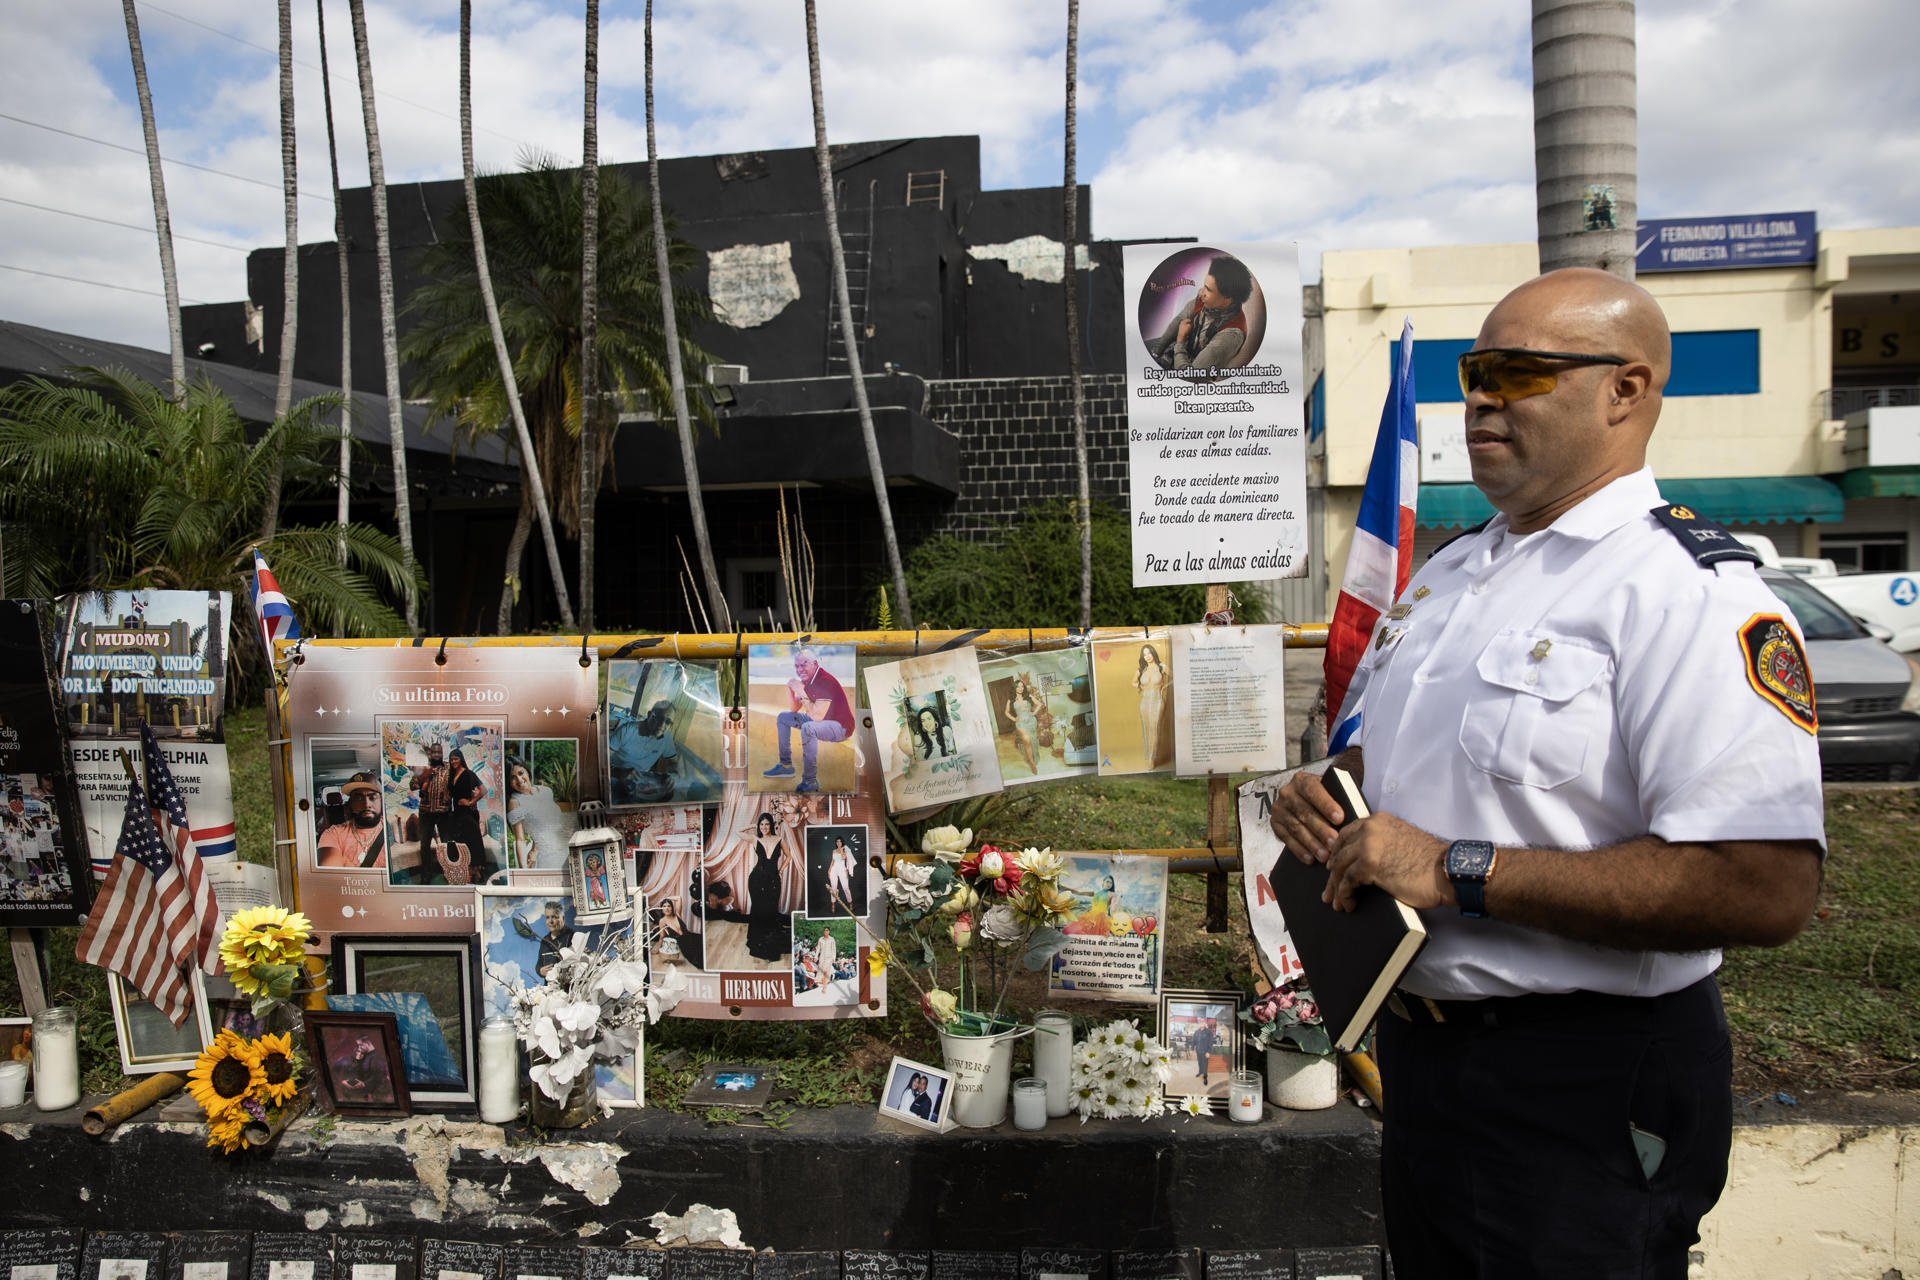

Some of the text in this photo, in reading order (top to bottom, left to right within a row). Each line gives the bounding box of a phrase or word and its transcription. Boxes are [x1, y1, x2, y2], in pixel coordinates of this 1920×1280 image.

[1660, 221, 1797, 243] FERNANDO VILLALONA
[1671, 245, 1728, 262] ORQUESTA
[1144, 364, 1281, 381] Rey medina & movimiento
[1138, 381, 1289, 398] unidos por la Dominicanidad.
[1175, 400, 1254, 415] Dicen presente.
[1130, 424, 1298, 442] Se solidarizan con los familiares
[1160, 445, 1171, 459] de
[1176, 448, 1198, 458] esas
[1201, 444, 1232, 458] almas
[1154, 472, 1279, 488] En ese accidente masivo
[1154, 490, 1279, 506] Donde cada dominicano
[1138, 508, 1295, 527] fue tocado de manera directa.
[1145, 553, 1168, 573] Paz
[1172, 559, 1181, 572] a
[1185, 551, 1204, 571] las
[1208, 550, 1246, 571] almas
[72, 654, 203, 671] MOVIMIENTO UNIDO
[86, 678, 103, 693] LA
[378, 687, 505, 702] Su ultima Foto
[344, 876, 370, 889] Tony
[341, 885, 376, 896] Blanco
[1098, 938, 1107, 946] de
[1062, 948, 1091, 956] dejaste
[1102, 960, 1112, 968] de
[1062, 969, 1096, 978] nosotros
[1102, 971, 1133, 980] siempre
[724, 979, 787, 1000] HERMOSA
[1077, 981, 1124, 990] recordamos
